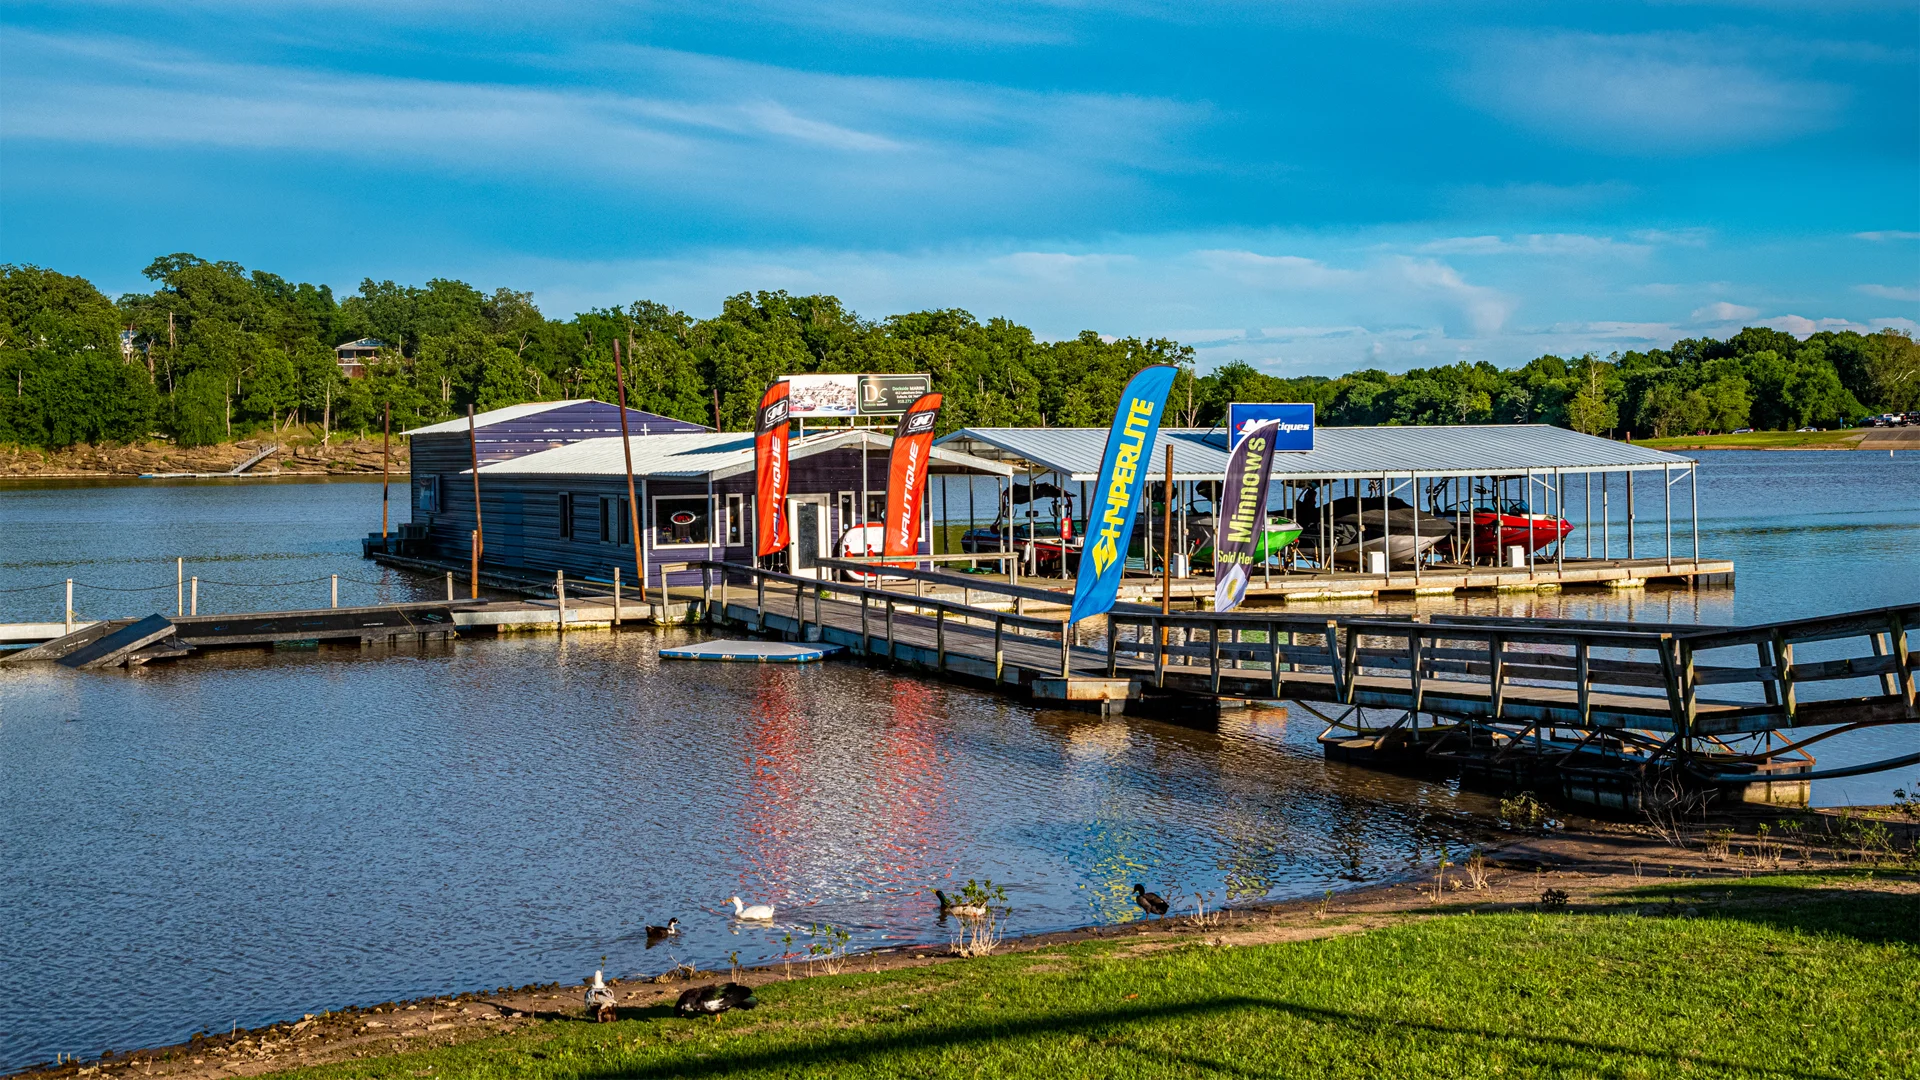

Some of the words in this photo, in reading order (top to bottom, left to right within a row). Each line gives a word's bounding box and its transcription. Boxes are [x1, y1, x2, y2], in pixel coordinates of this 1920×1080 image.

[772, 435, 781, 547] NAUTIQUE
[900, 440, 919, 548] NAUTIQUE
[1101, 397, 1154, 538] HYPERLITE
[1227, 437, 1266, 543] Minnows
[1218, 550, 1236, 563] Sold
